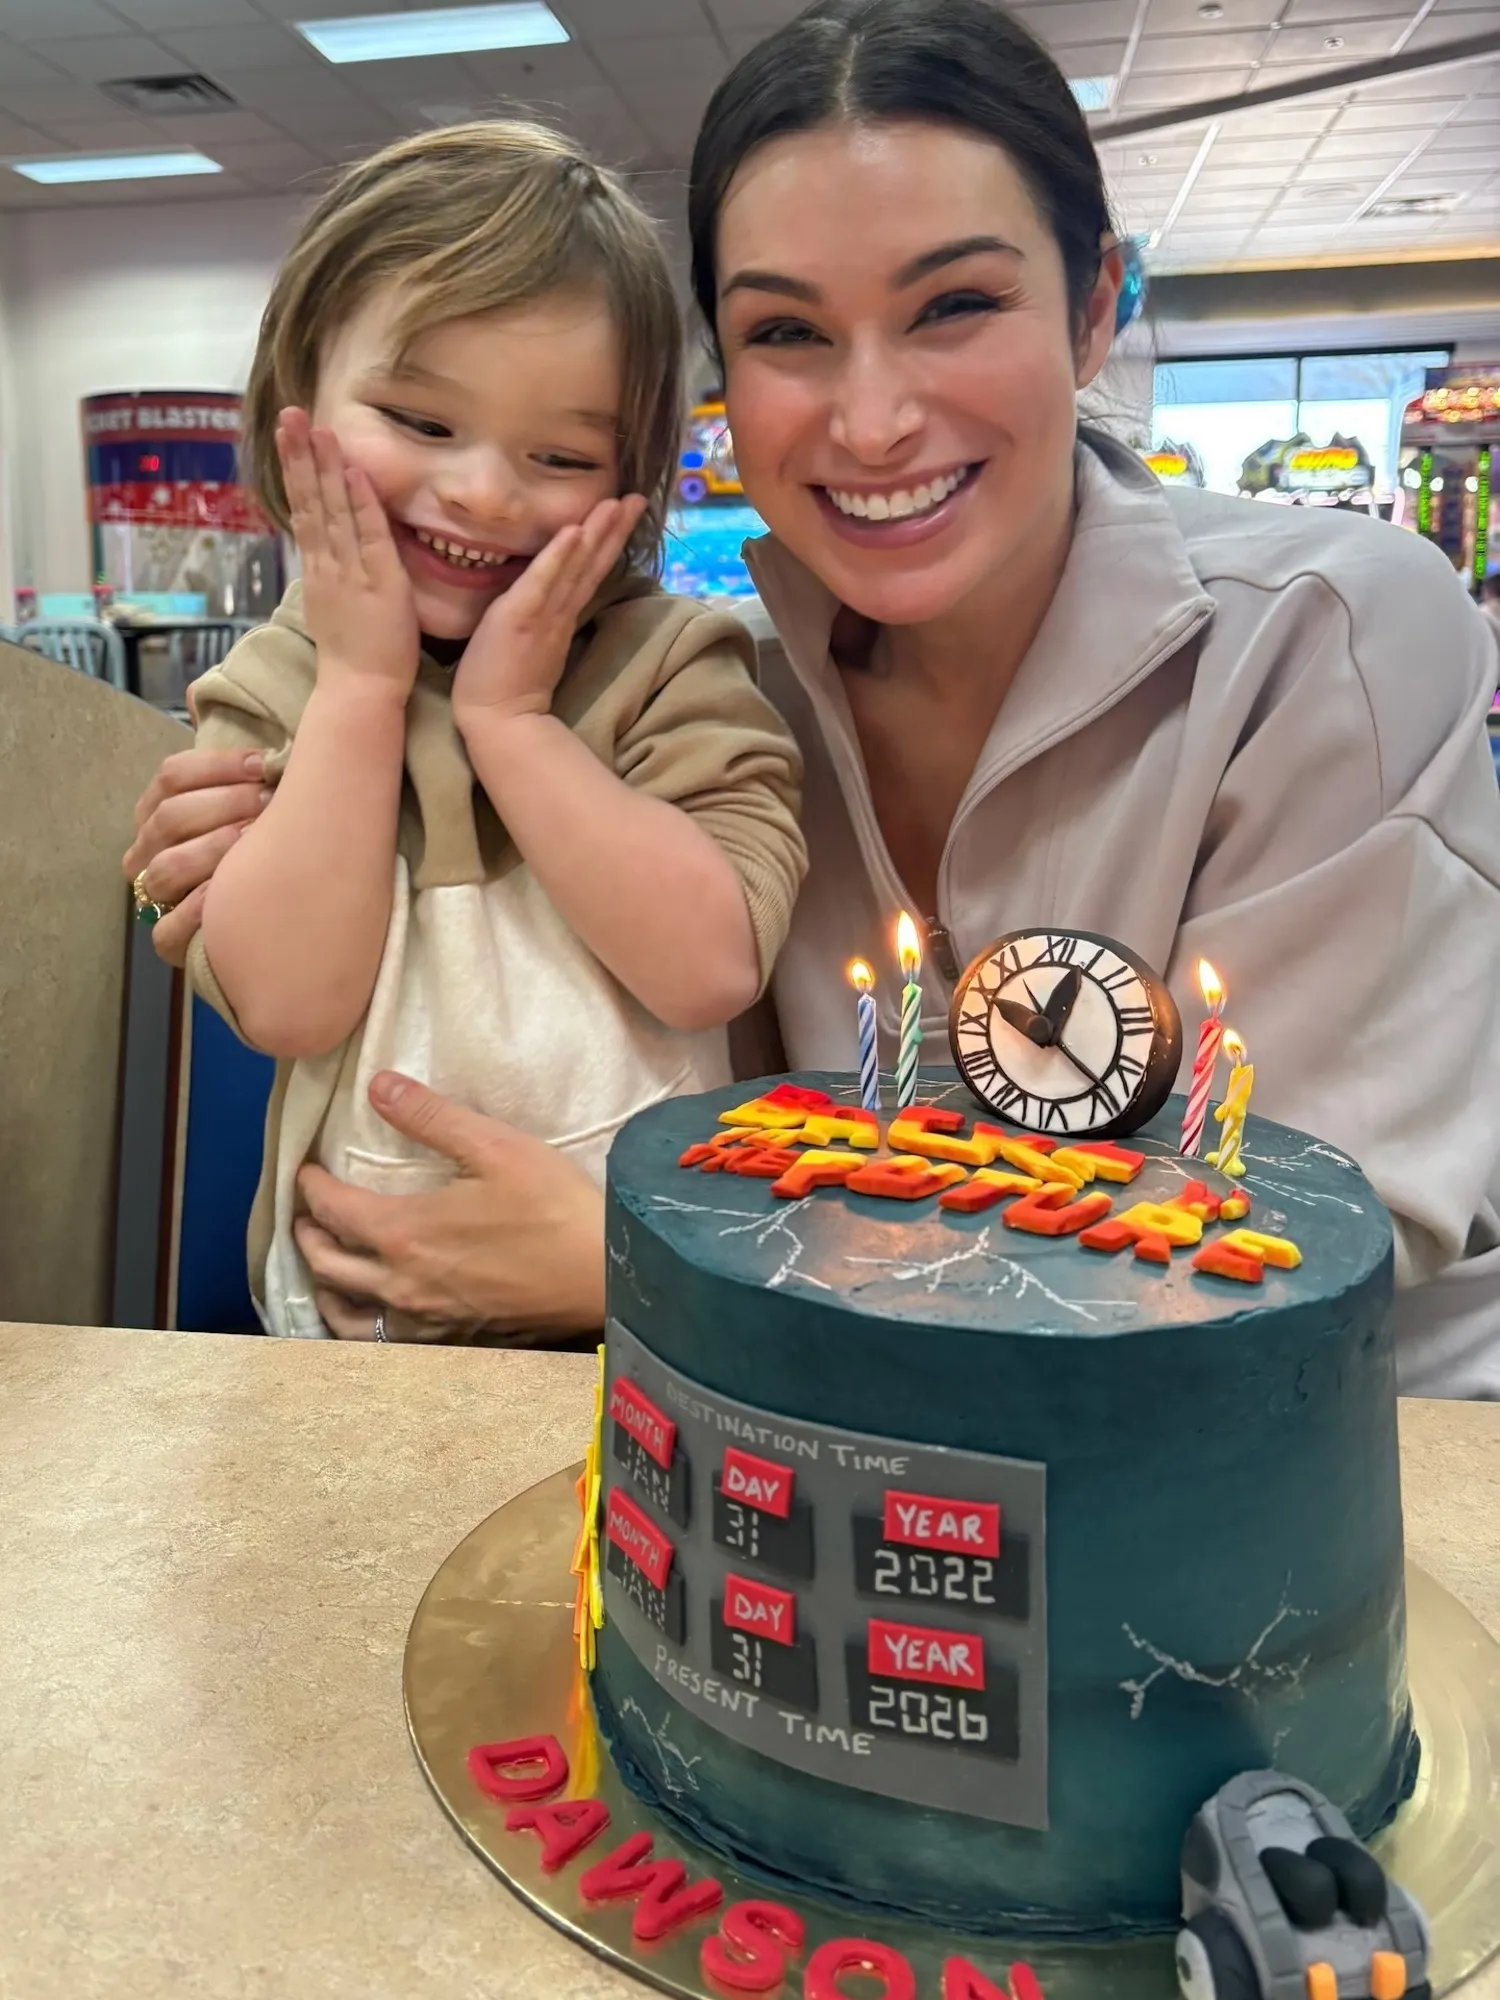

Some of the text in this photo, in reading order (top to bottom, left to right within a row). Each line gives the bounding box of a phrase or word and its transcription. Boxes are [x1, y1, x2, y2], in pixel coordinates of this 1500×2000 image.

[770, 1148, 1303, 1284] FUTURE
[609, 1392, 664, 1457] MONTH
[666, 1380, 910, 1475] DESTINATION TIME
[620, 1430, 671, 1513] JAN
[726, 1464, 780, 1503] DAY
[609, 1510, 660, 1569] MONTH
[725, 1502, 760, 1558] 31
[896, 1502, 985, 1544] YEAR
[874, 1549, 996, 1604] 2022
[734, 1592, 785, 1633] DAY
[732, 1632, 763, 1688] 31
[883, 1633, 975, 1677] YEAR
[655, 1644, 876, 1755] PRESENT TIME
[868, 1684, 988, 1741] 2026
